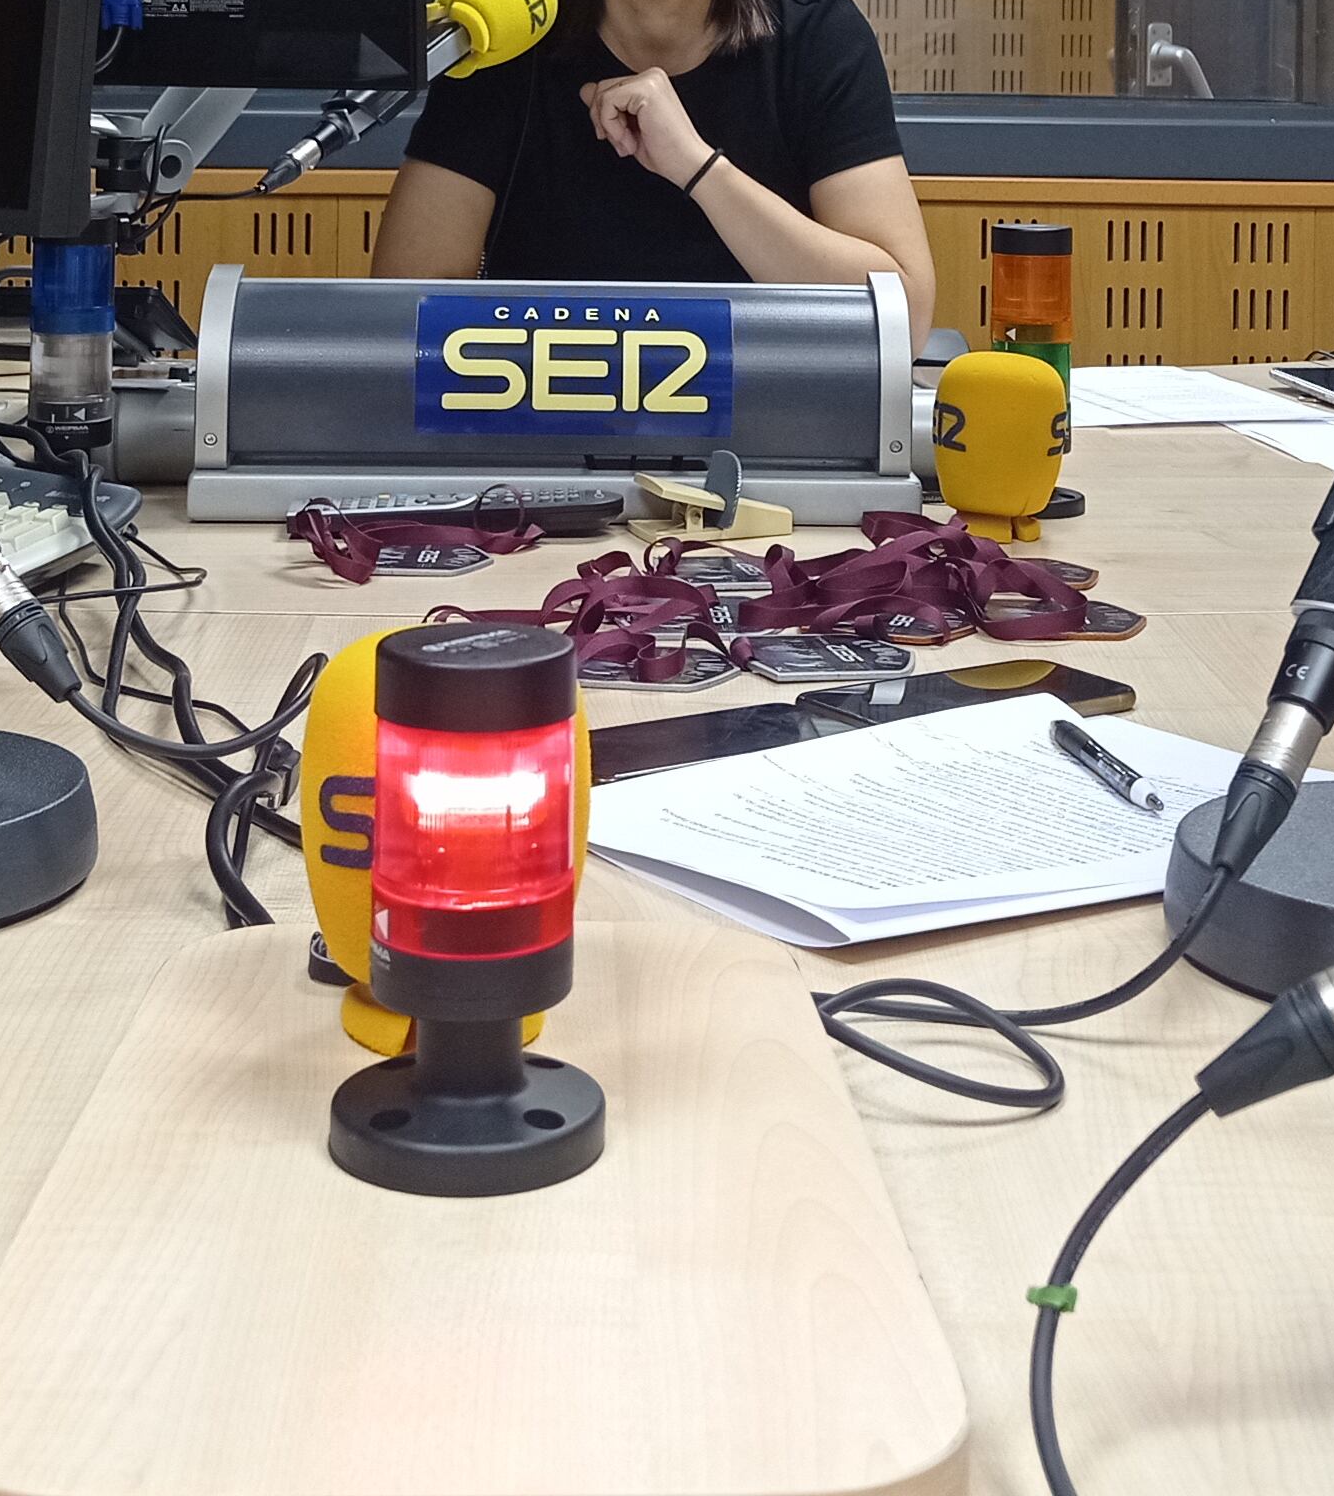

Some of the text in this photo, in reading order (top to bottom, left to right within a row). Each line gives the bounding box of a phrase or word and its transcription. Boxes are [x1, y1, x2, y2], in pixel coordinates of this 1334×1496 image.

[494, 306, 661, 322] CADENA
[441, 327, 709, 414] SER
[1285, 663, 1310, 680] CE
